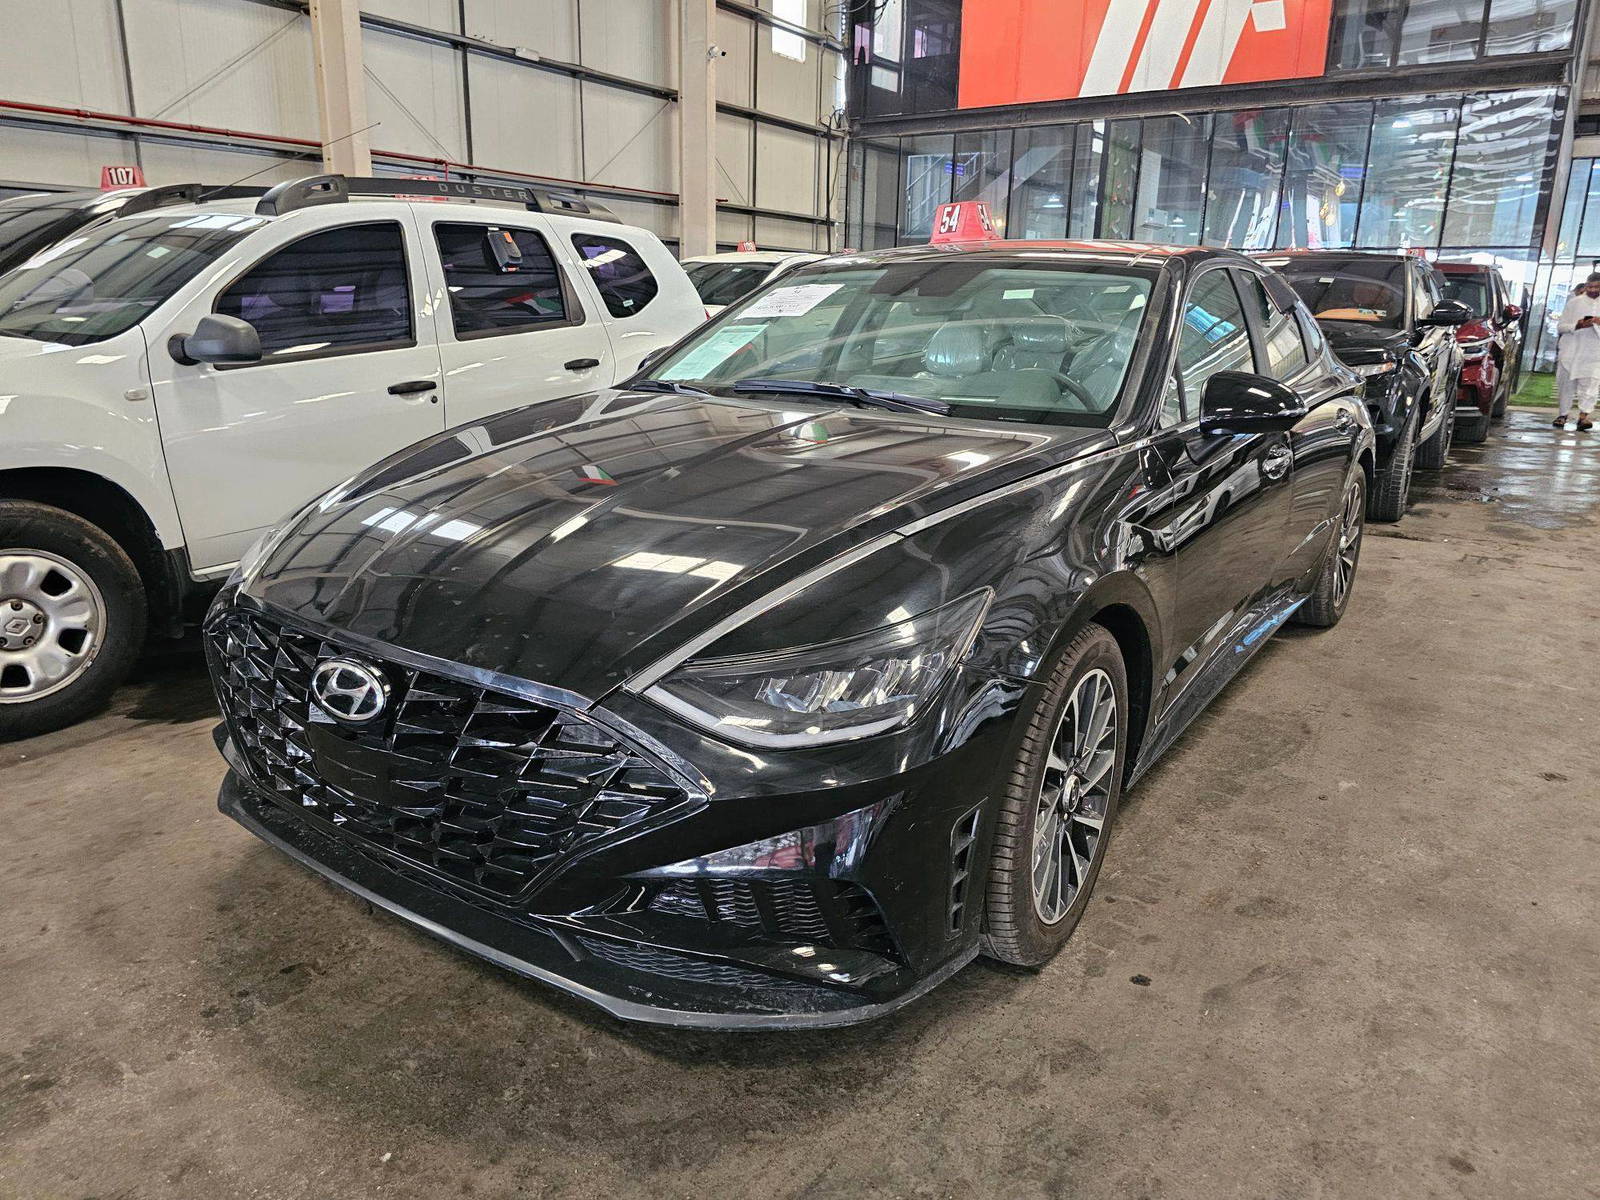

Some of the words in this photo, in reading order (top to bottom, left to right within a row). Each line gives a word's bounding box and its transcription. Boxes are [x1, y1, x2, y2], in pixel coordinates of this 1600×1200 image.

[109, 167, 134, 185] 107
[438, 183, 529, 200] DUSTER
[940, 204, 961, 233] 54
